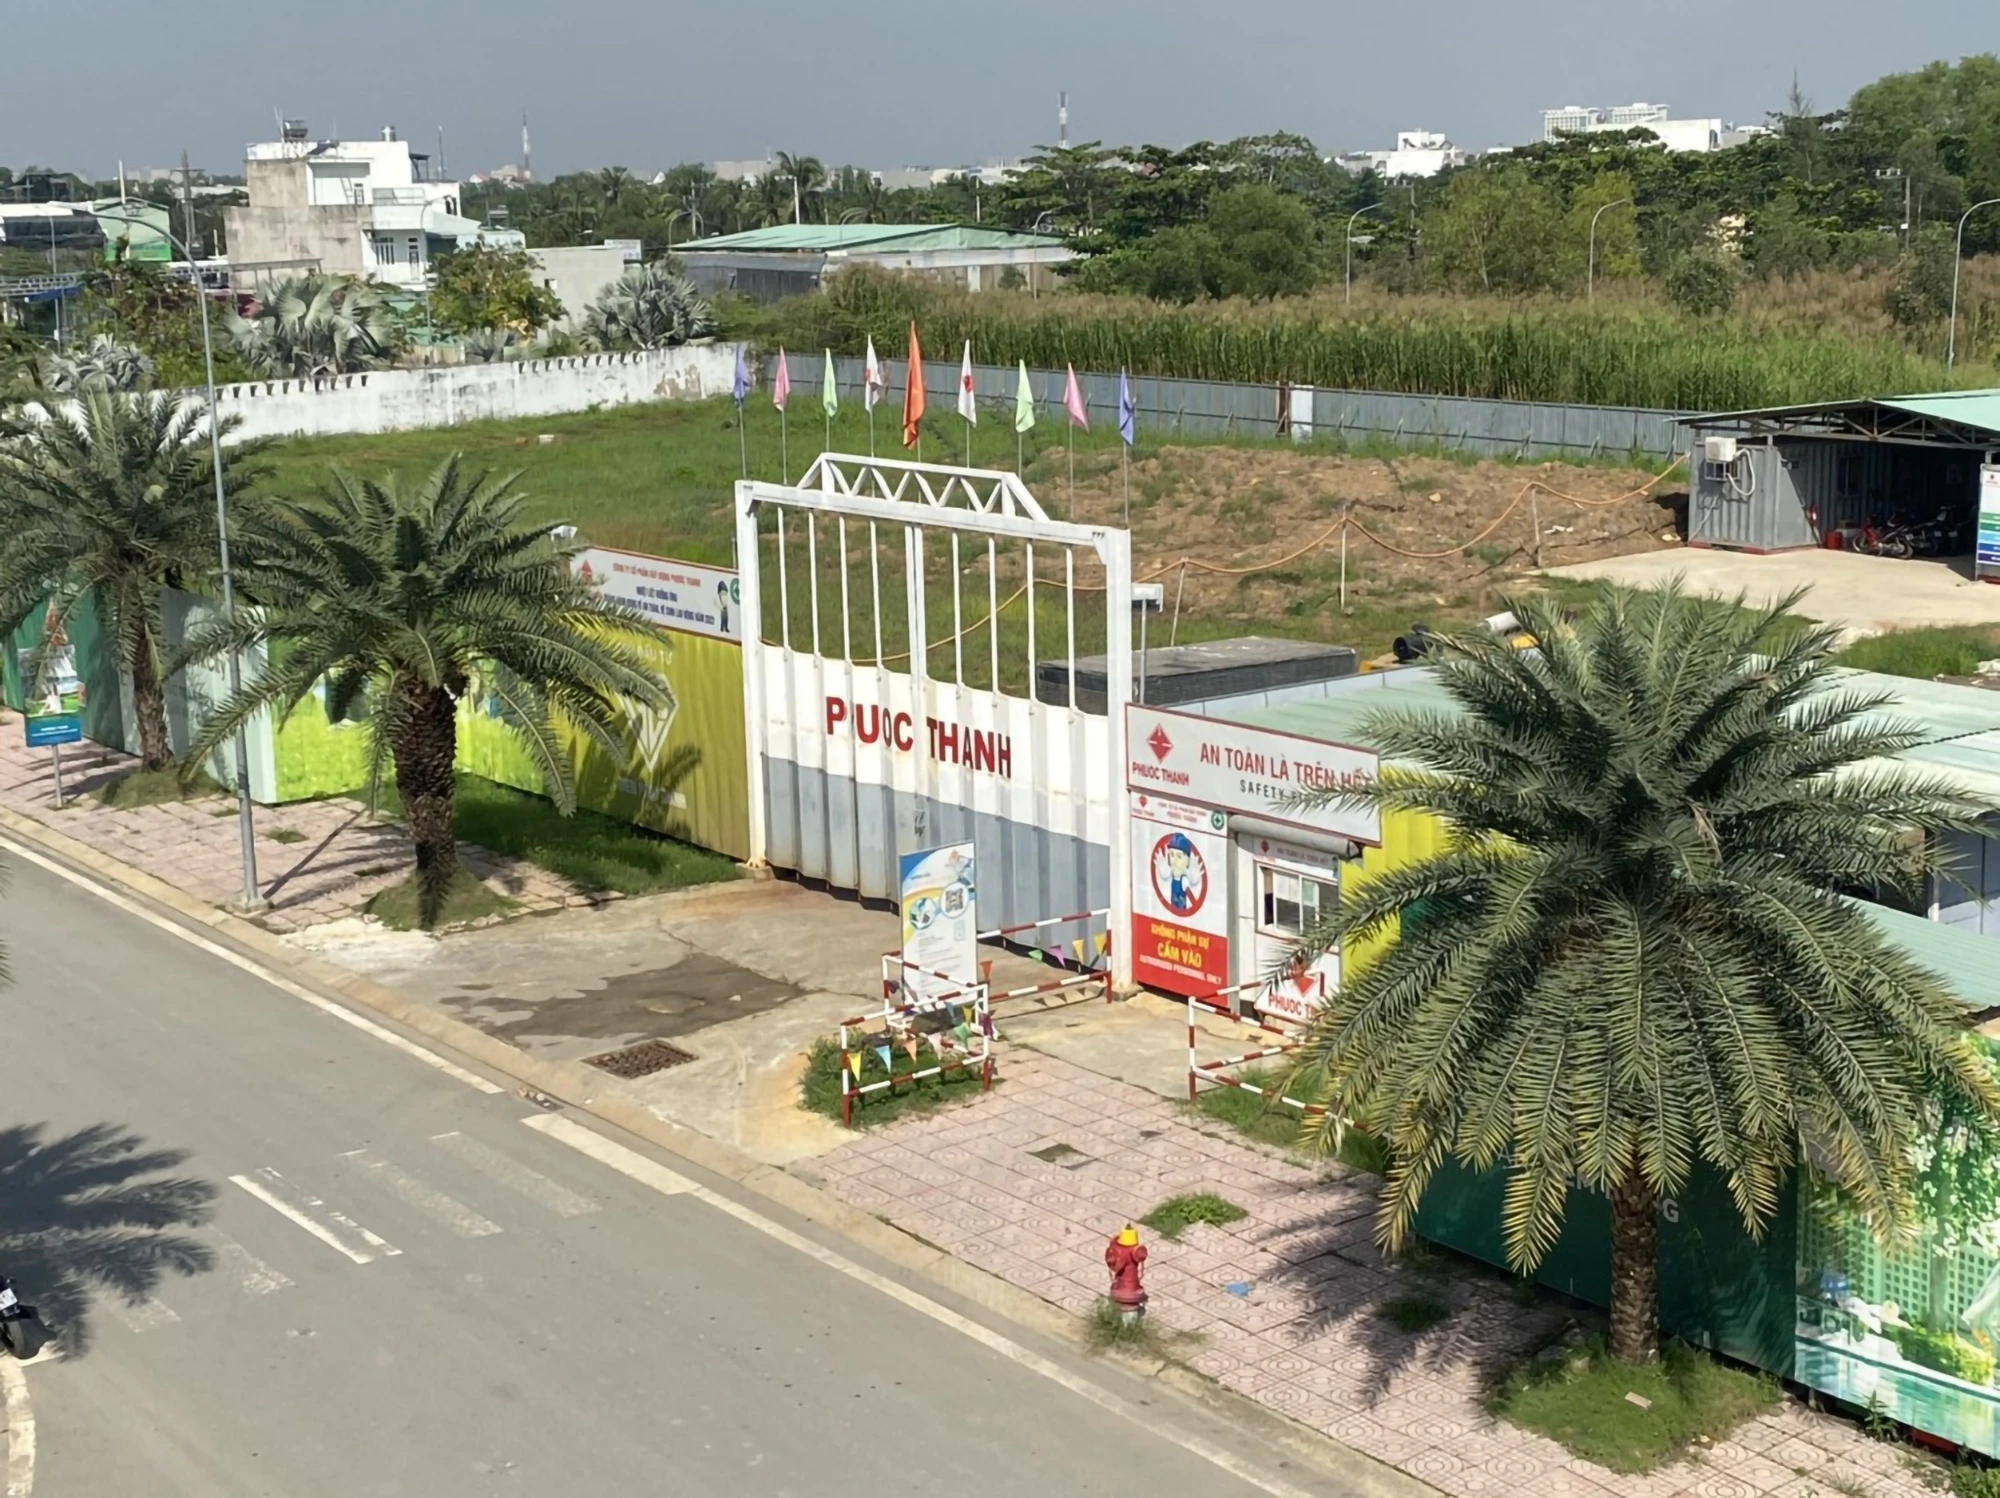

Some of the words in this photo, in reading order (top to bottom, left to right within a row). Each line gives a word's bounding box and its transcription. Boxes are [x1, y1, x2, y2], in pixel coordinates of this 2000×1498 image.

[926, 716, 1011, 779] THANH
[1200, 742, 1220, 766] AN
[1224, 745, 1264, 775] TOÀN
[1270, 753, 1289, 781] LÀ
[1240, 779, 1284, 800] SAFETY
[1157, 940, 1180, 962] CẤM
[1181, 947, 1202, 968] VÀO
[1268, 993, 1302, 1016] PHUOC
